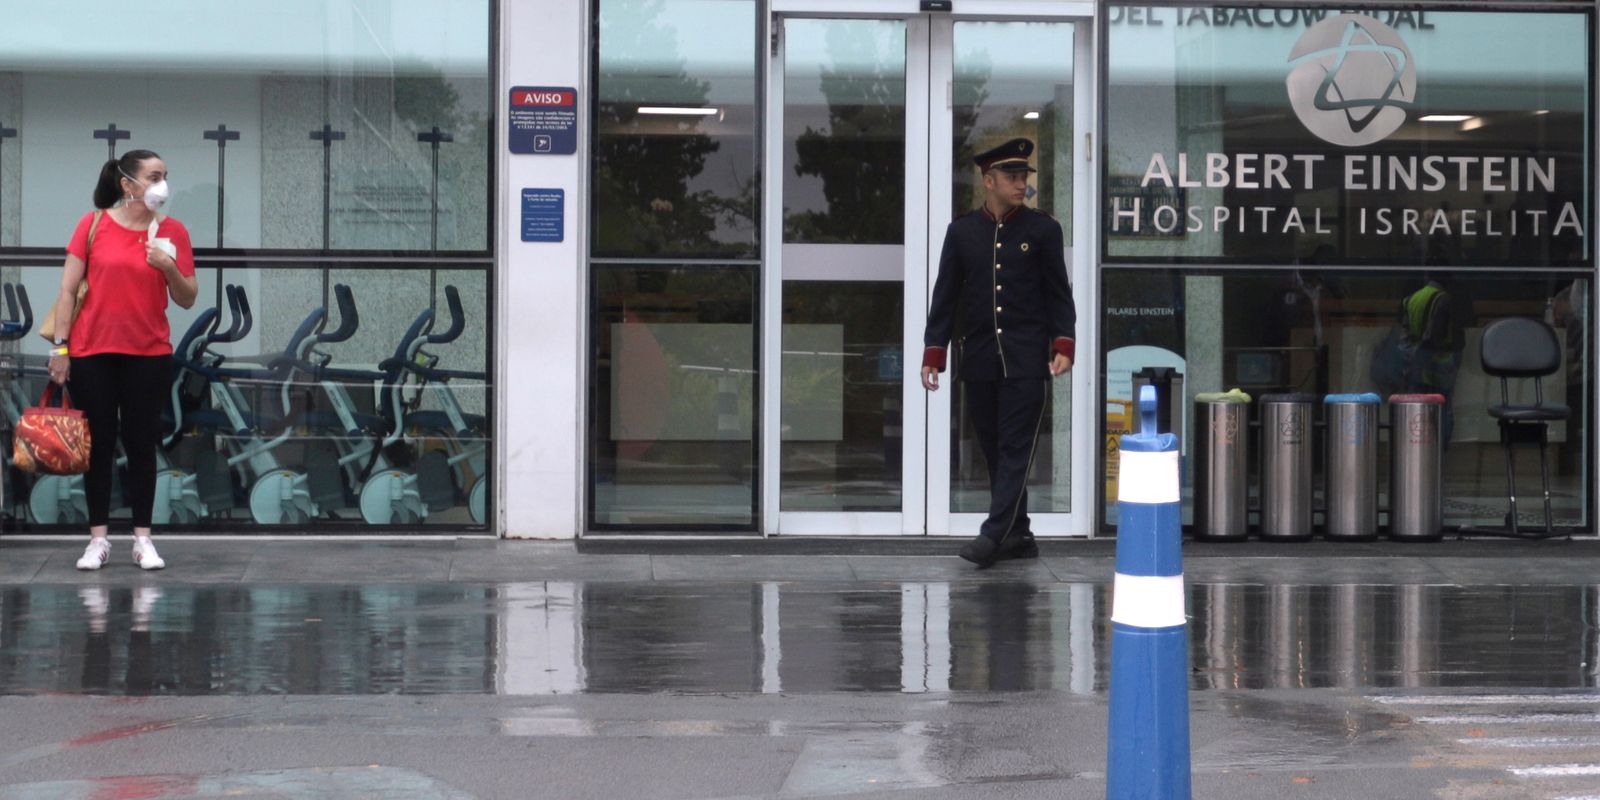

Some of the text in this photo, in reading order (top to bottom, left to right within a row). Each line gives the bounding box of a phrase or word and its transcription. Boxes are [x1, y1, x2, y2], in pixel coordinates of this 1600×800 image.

[524, 93, 562, 104] AVISO
[1141, 153, 1556, 192] ALBERT EINSTEIN
[1112, 197, 1584, 236] HOSPITAL ISRAELITA
[1107, 306, 1175, 316] PILARES EINSTEIN
